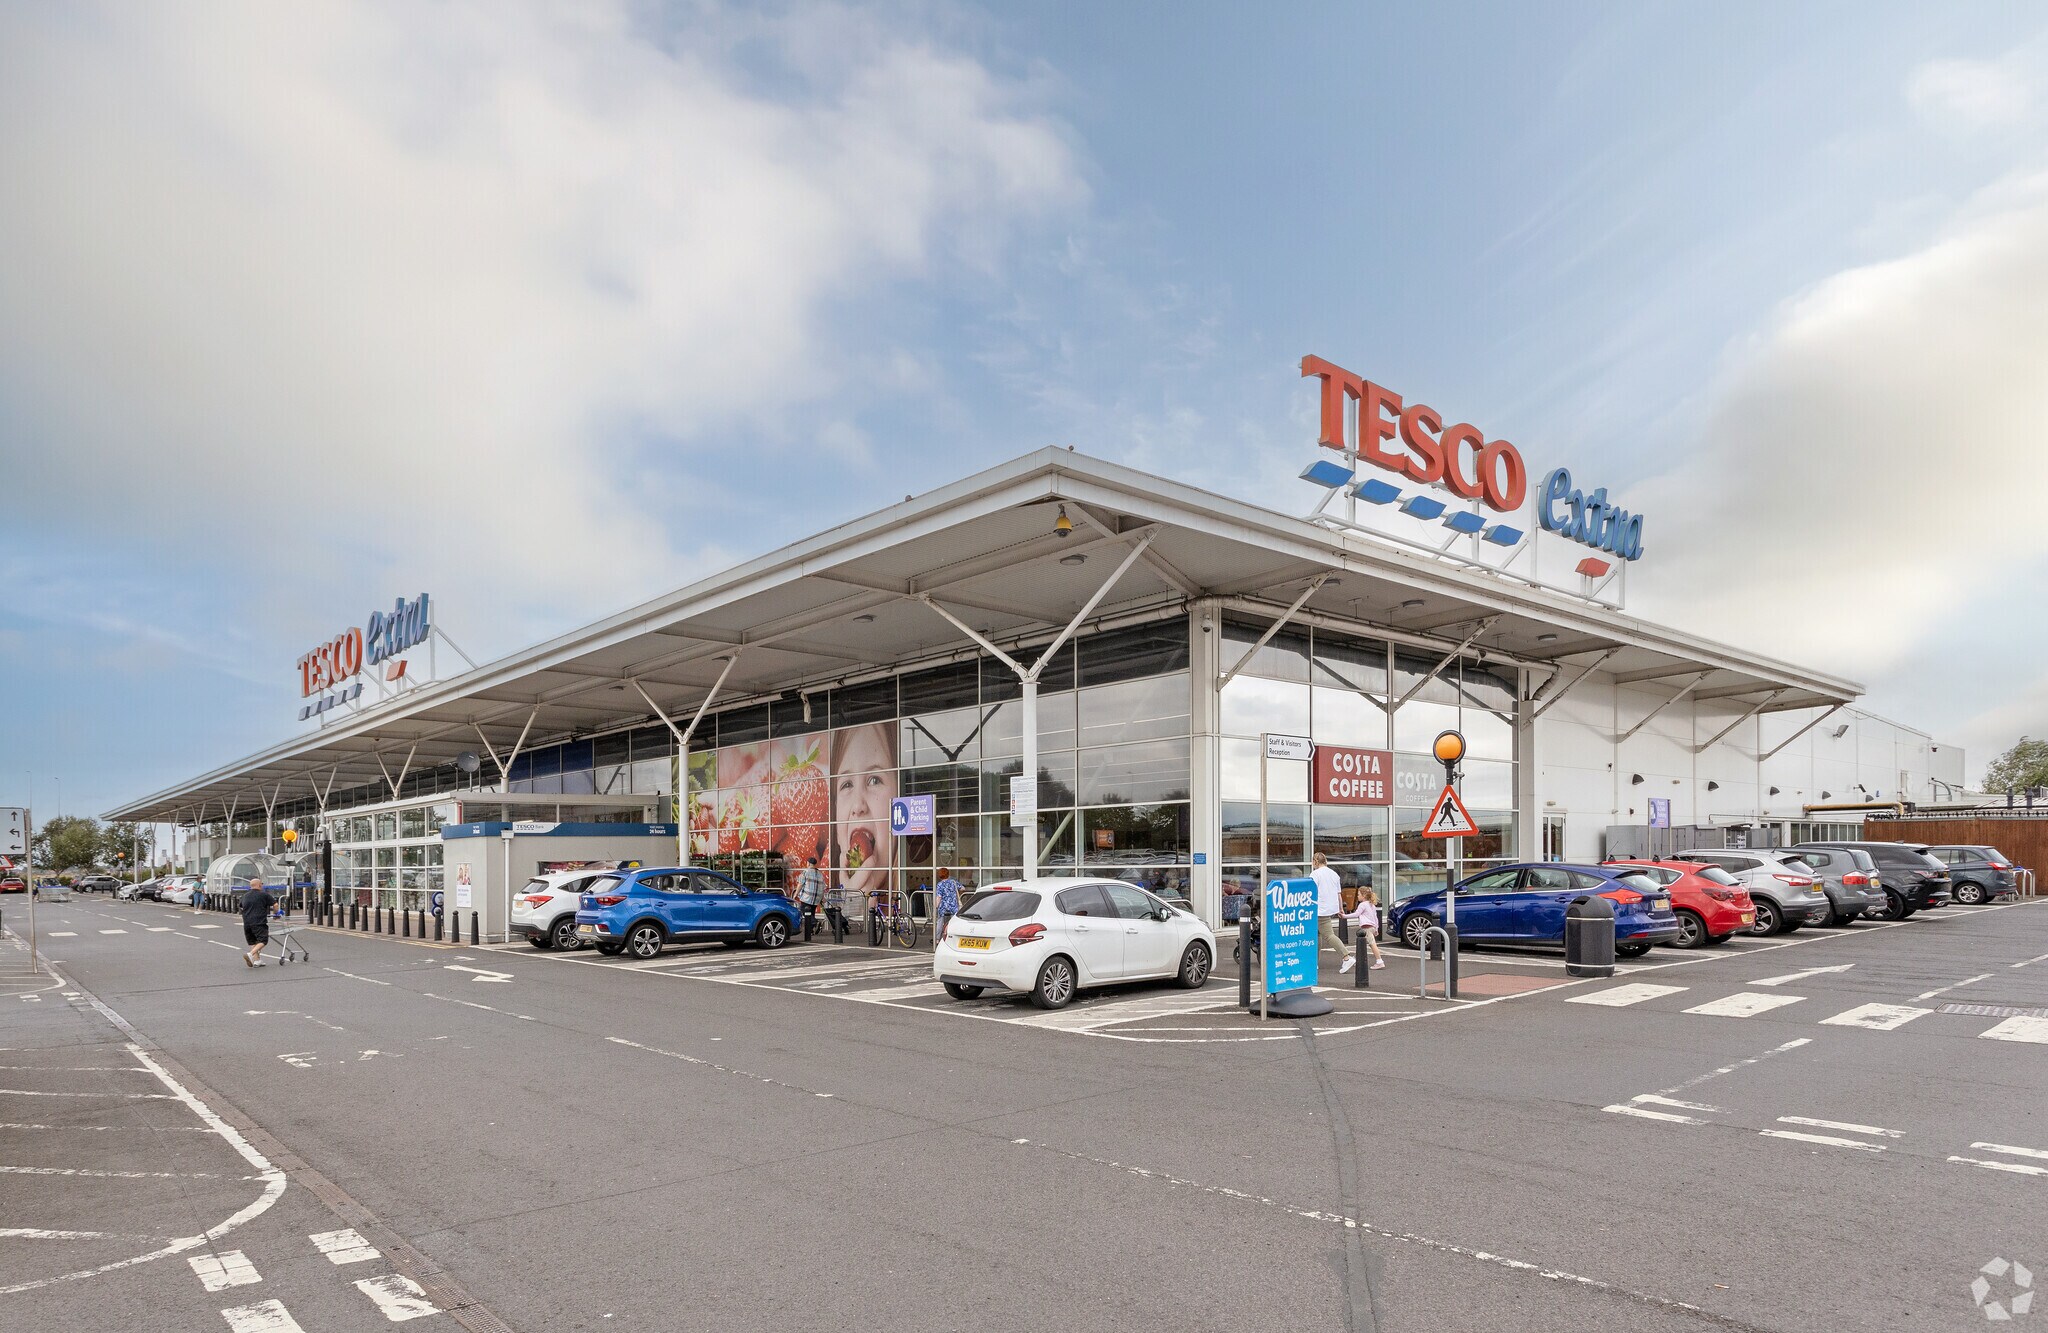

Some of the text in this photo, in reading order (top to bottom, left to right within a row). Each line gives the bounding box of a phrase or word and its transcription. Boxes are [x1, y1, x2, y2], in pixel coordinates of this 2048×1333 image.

[1301, 354, 1645, 561] TESCO extra
[297, 593, 430, 698] TESCO extra
[1269, 748, 1290, 756] Reception
[1332, 752, 1380, 776] COSTA
[1330, 778, 1384, 798] COFFEE
[1396, 771, 1436, 792] COSTA
[1406, 794, 1428, 802] COFFEE
[1267, 880, 1316, 910] Waves
[1274, 909, 1314, 923] Hand Car
[1280, 922, 1304, 936] Wash
[1287, 958, 1299, 967] 5pm
